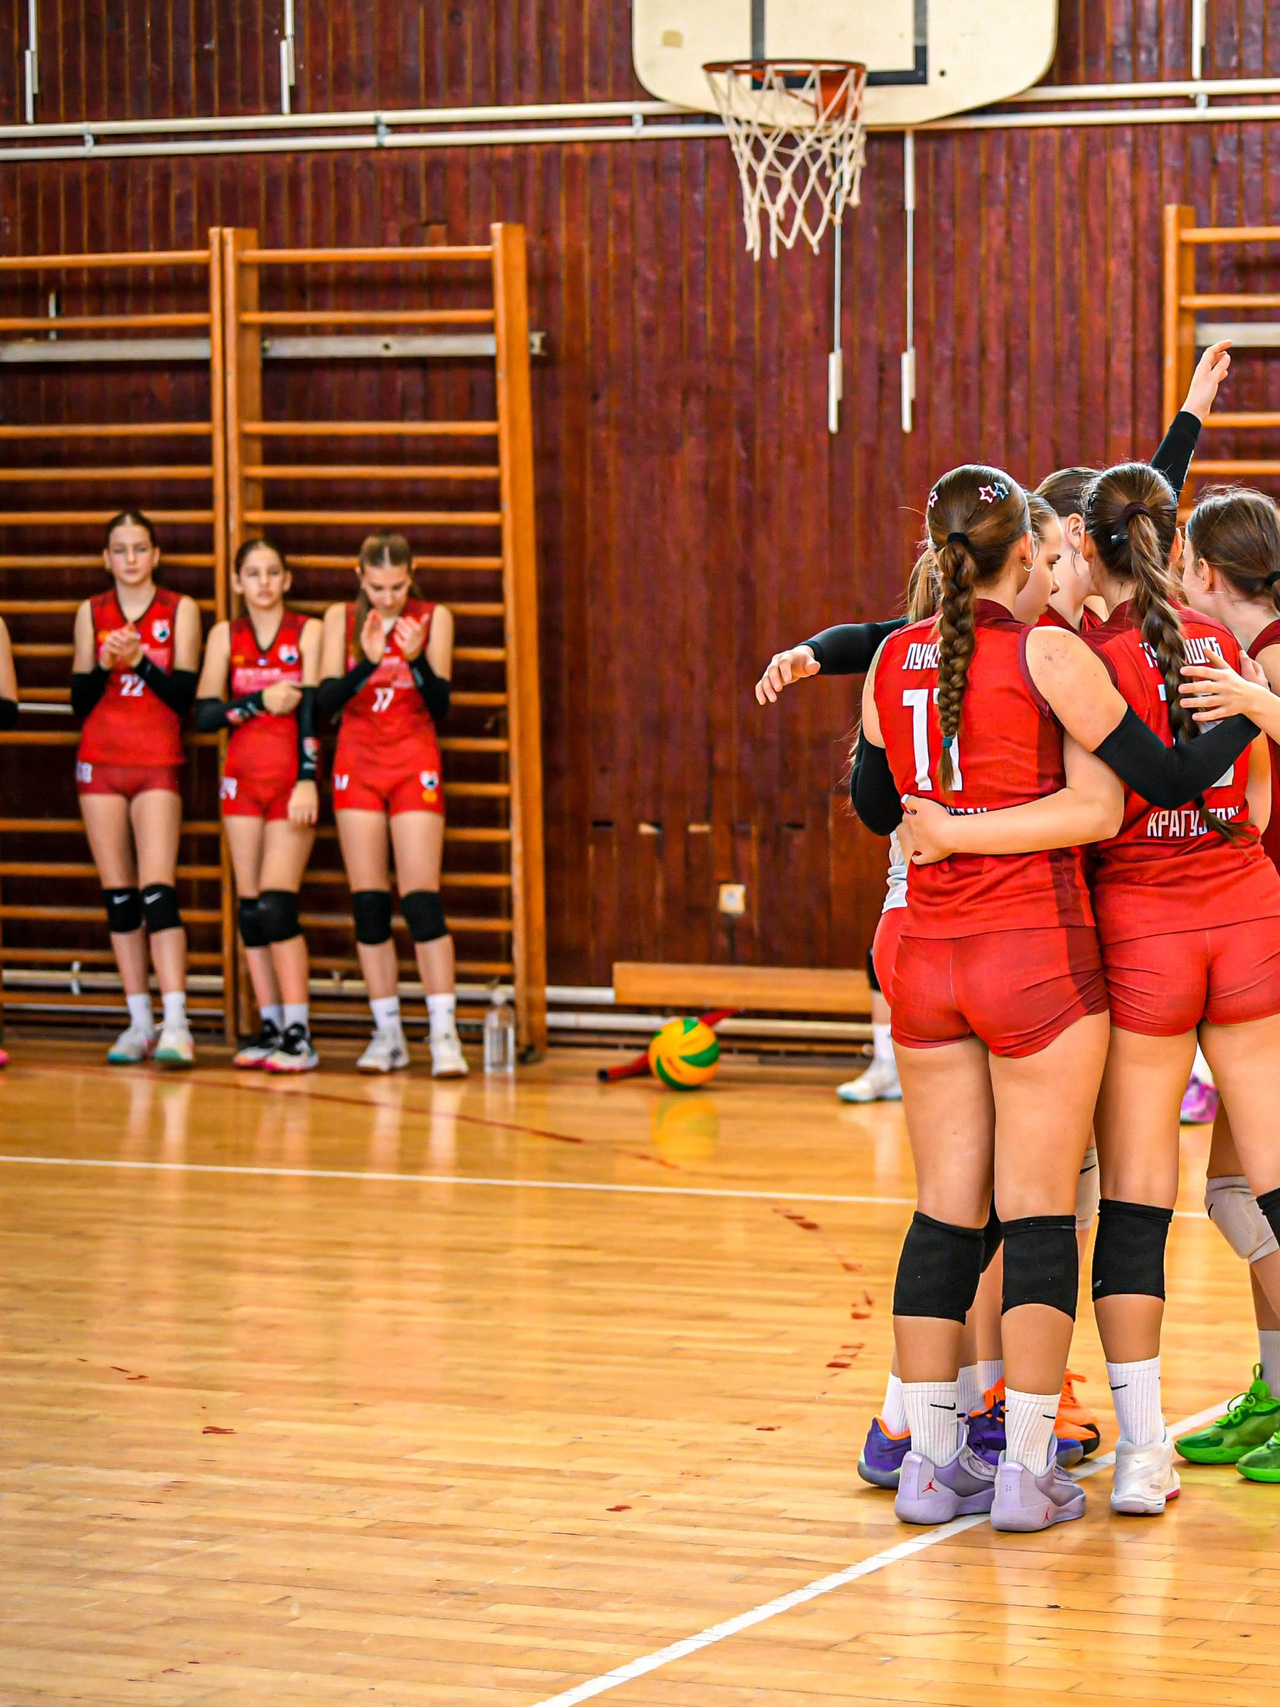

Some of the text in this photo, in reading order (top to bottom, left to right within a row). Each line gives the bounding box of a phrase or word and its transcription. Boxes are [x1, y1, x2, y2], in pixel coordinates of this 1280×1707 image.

[902, 643, 942, 670] ЛУКО
[120, 673, 146, 697] 22
[1146, 806, 1239, 838] КРАГУЈ
